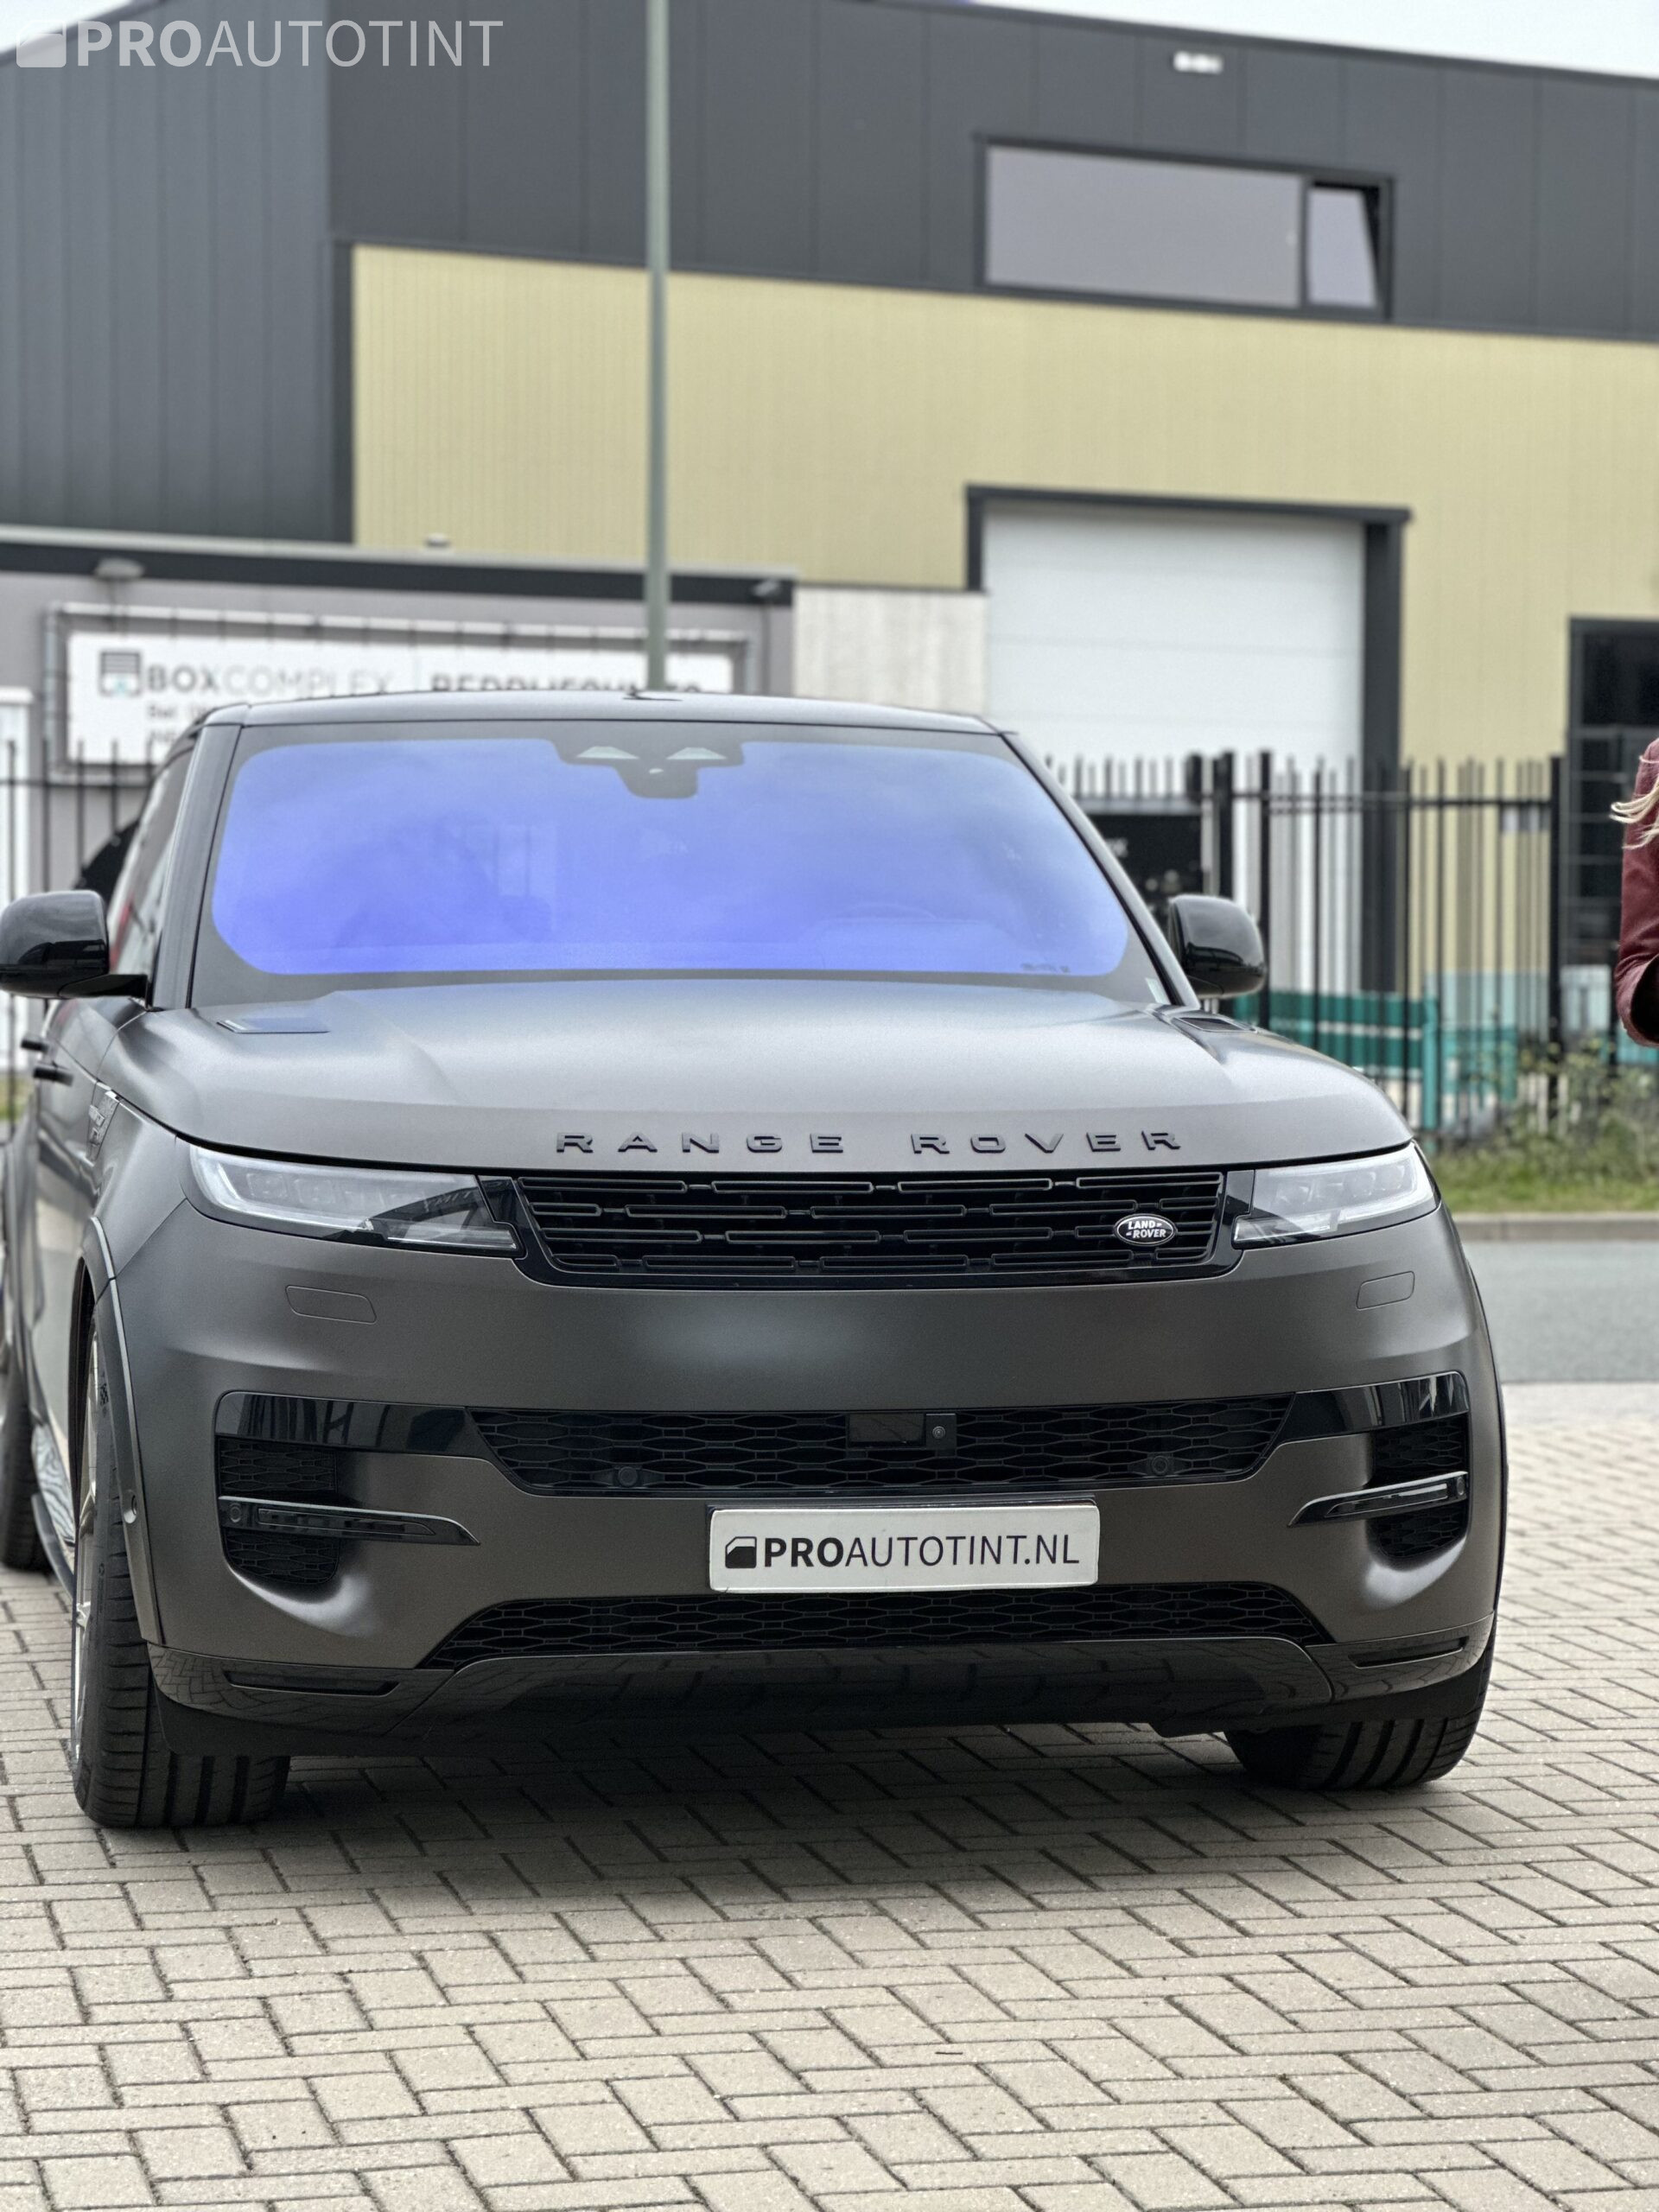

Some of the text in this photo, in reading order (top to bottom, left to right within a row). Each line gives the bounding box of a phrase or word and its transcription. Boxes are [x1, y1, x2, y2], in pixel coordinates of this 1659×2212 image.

[556, 1130, 1181, 1154] RANGE ROVER
[764, 1534, 1079, 1567] PROAUTOTINT.NL
